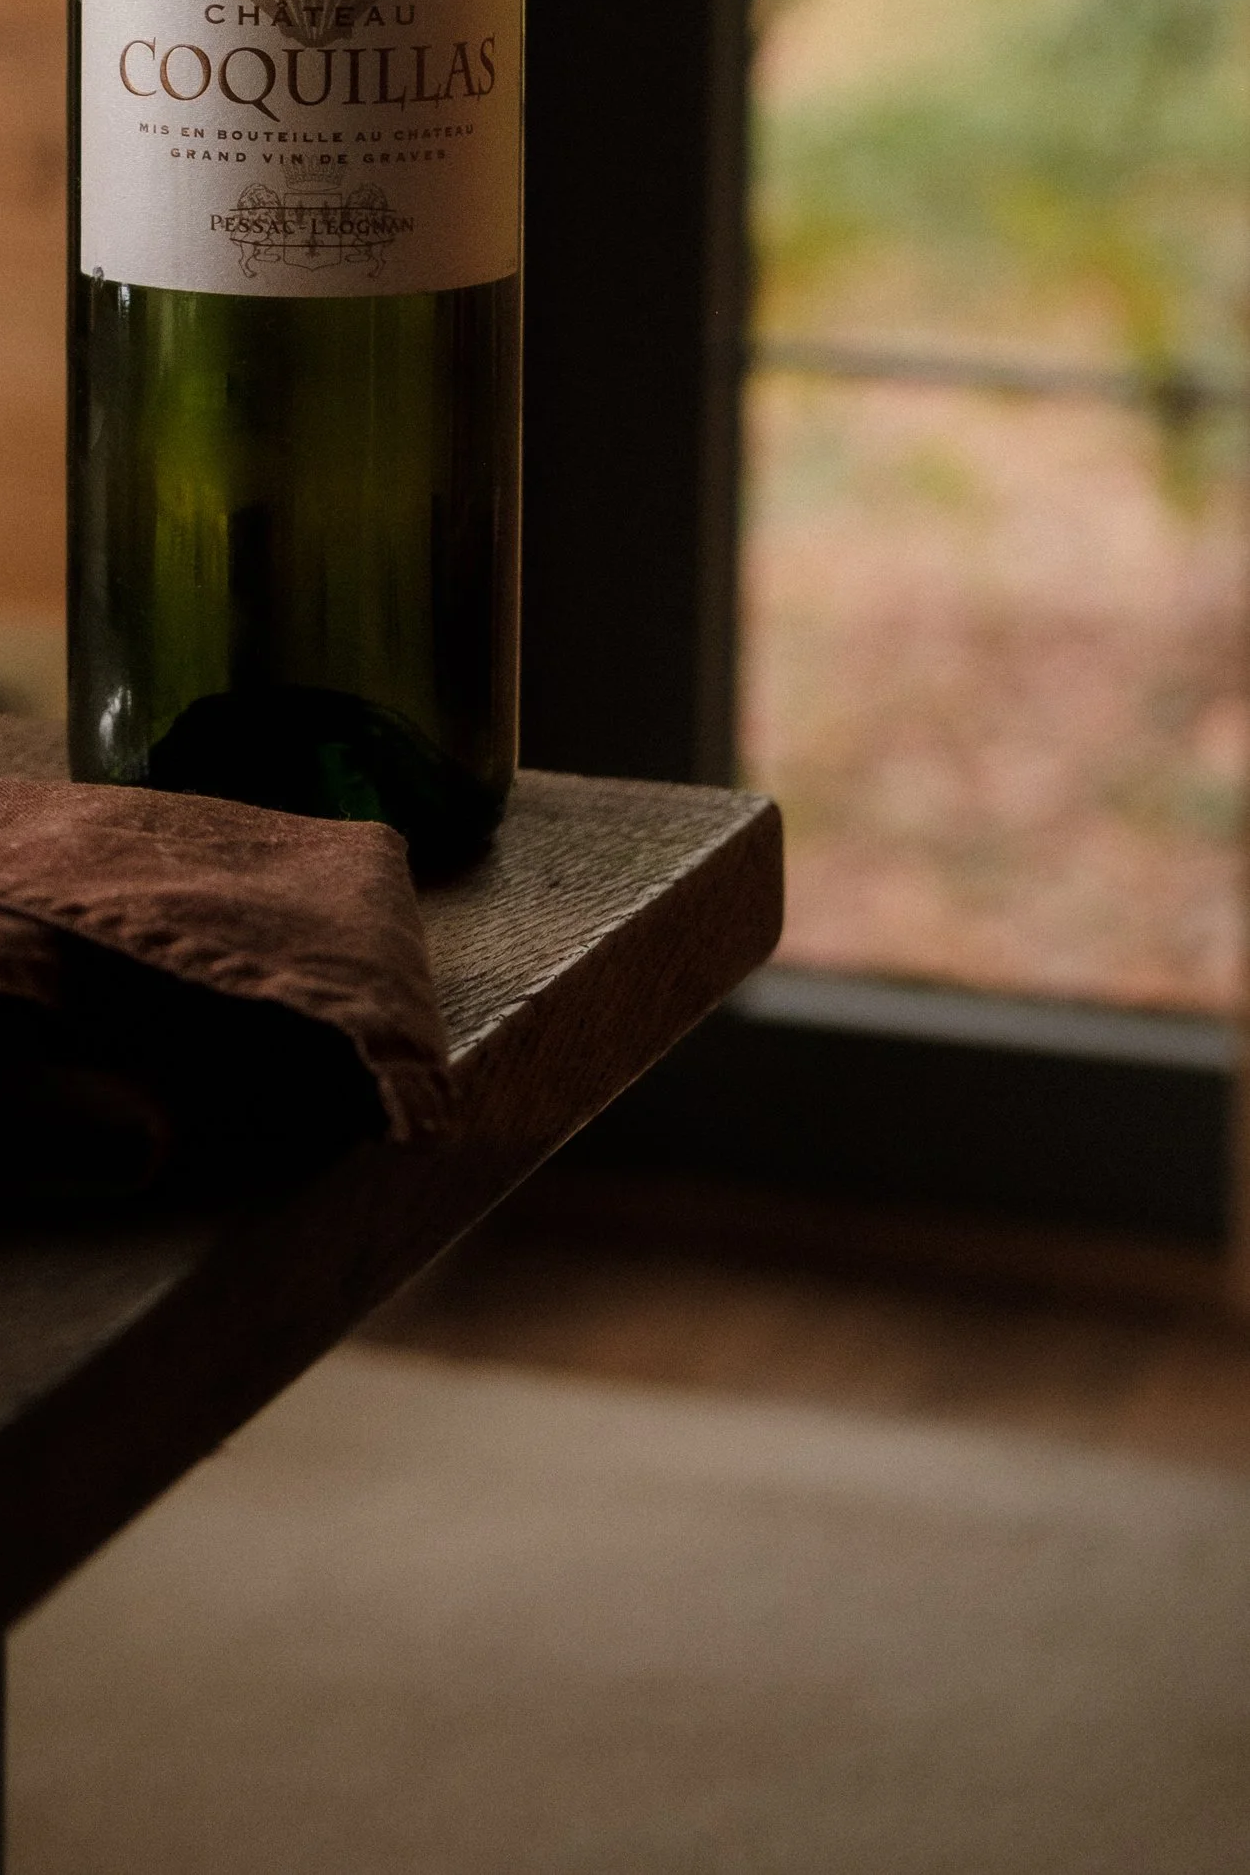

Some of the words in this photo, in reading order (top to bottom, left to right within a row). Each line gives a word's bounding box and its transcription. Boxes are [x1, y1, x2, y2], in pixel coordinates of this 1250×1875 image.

[203, 0, 416, 27] CHÂTEAU
[118, 33, 497, 123] COQUILLAS
[139, 123, 170, 135] MIS
[180, 127, 206, 138] EN
[217, 129, 343, 143] BOUTEILLE
[355, 131, 382, 142] AU
[170, 148, 247, 163] GRAND
[262, 153, 303, 165] VIN
[320, 153, 349, 165] DE
[362, 150, 447, 164] GRAVES
